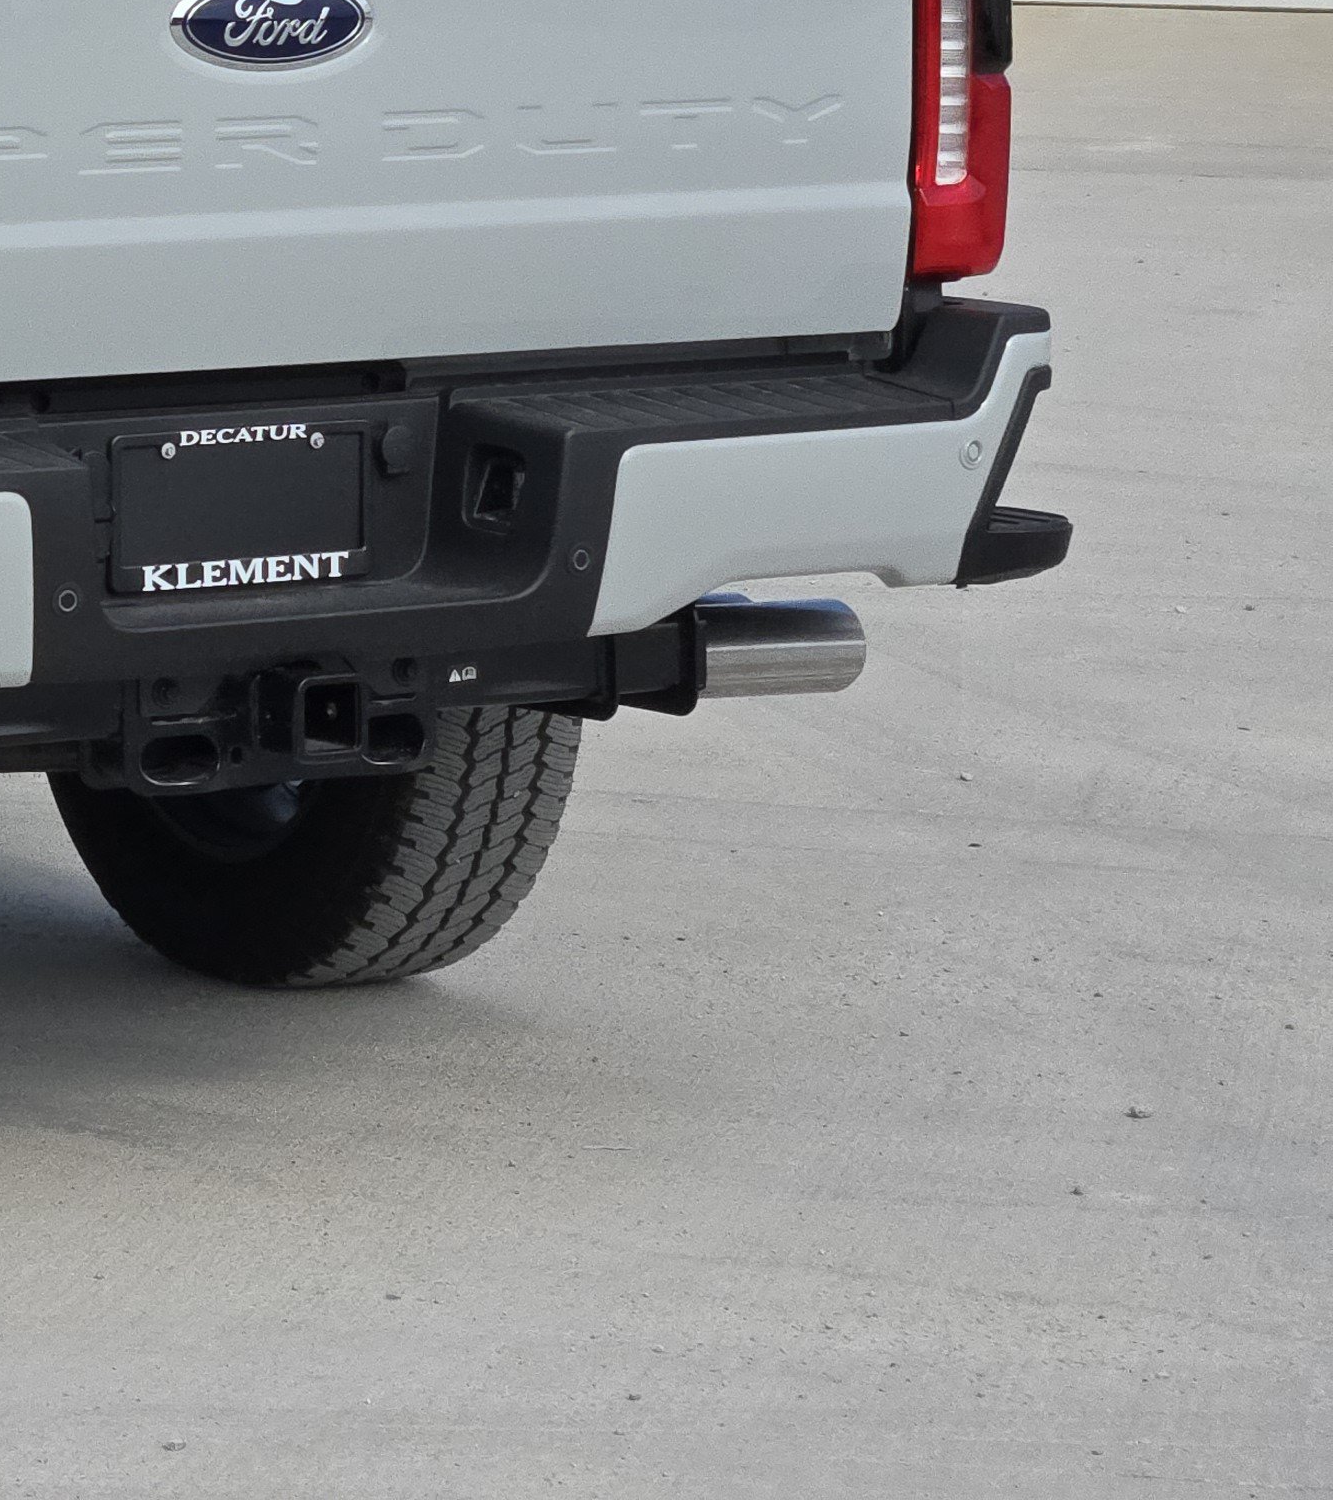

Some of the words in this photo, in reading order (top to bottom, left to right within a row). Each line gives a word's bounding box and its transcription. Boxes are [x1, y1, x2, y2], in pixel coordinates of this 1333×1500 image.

[381, 94, 843, 162] DUTY
[179, 423, 308, 447] DECATUR
[142, 551, 349, 592] KLEMENT
